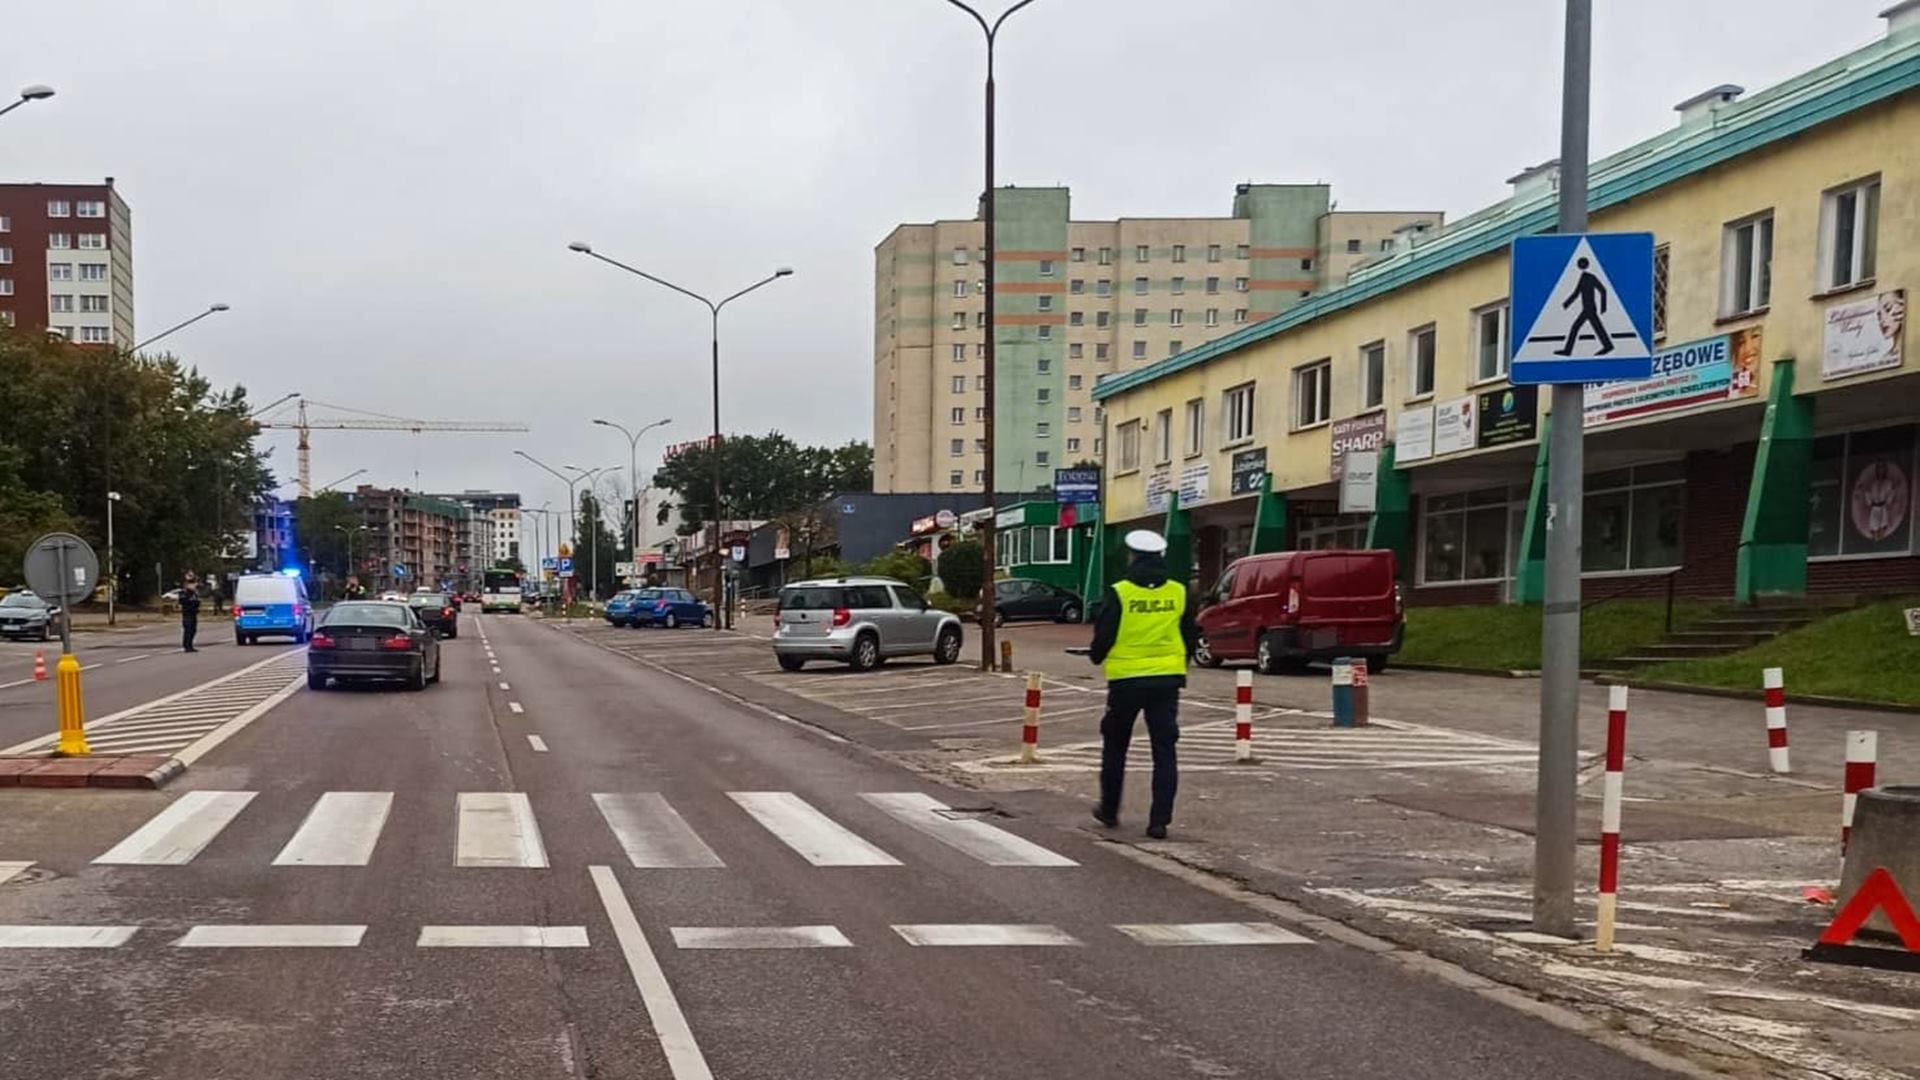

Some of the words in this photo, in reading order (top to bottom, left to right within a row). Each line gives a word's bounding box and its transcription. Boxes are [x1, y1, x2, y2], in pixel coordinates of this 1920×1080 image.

[1653, 342, 1725, 376] ZĘBOWE
[1332, 431, 1384, 456] SHARP
[561, 558, 571, 570] P
[1129, 600, 1175, 613] POLICJA
